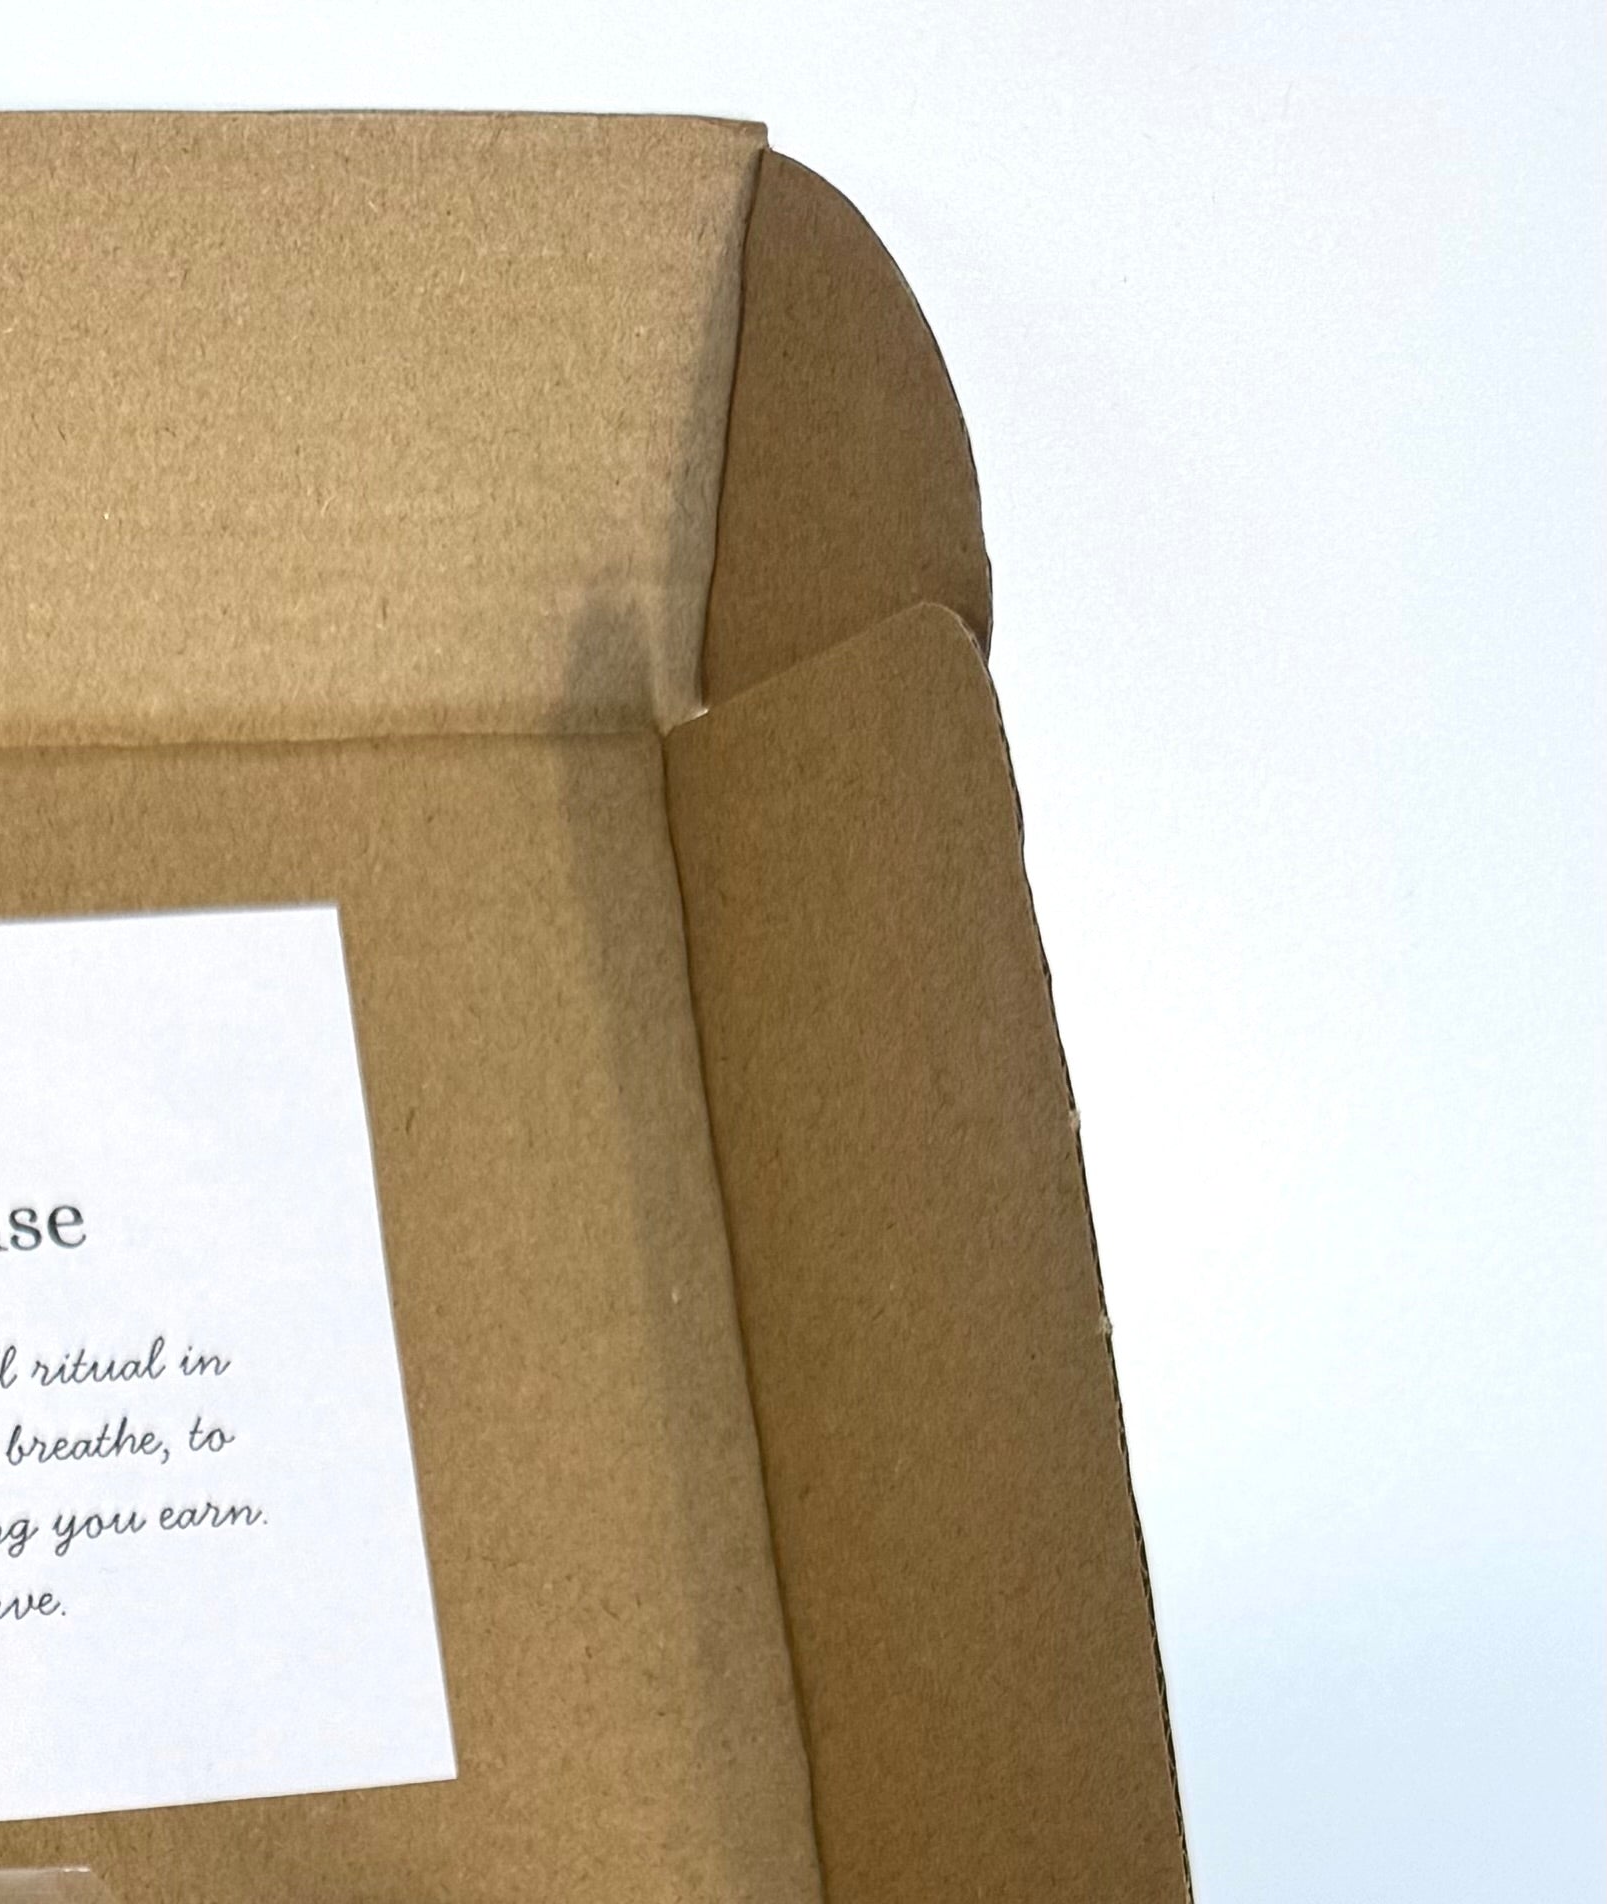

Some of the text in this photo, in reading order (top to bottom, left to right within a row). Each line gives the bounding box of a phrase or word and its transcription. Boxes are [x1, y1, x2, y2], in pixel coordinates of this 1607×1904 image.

[31, 1335, 166, 1386] ritual
[179, 1346, 231, 1376] in
[6, 1416, 170, 1466] breathe,
[189, 1416, 235, 1452] to
[52, 1511, 147, 1557] you
[159, 1502, 267, 1530] earn.
